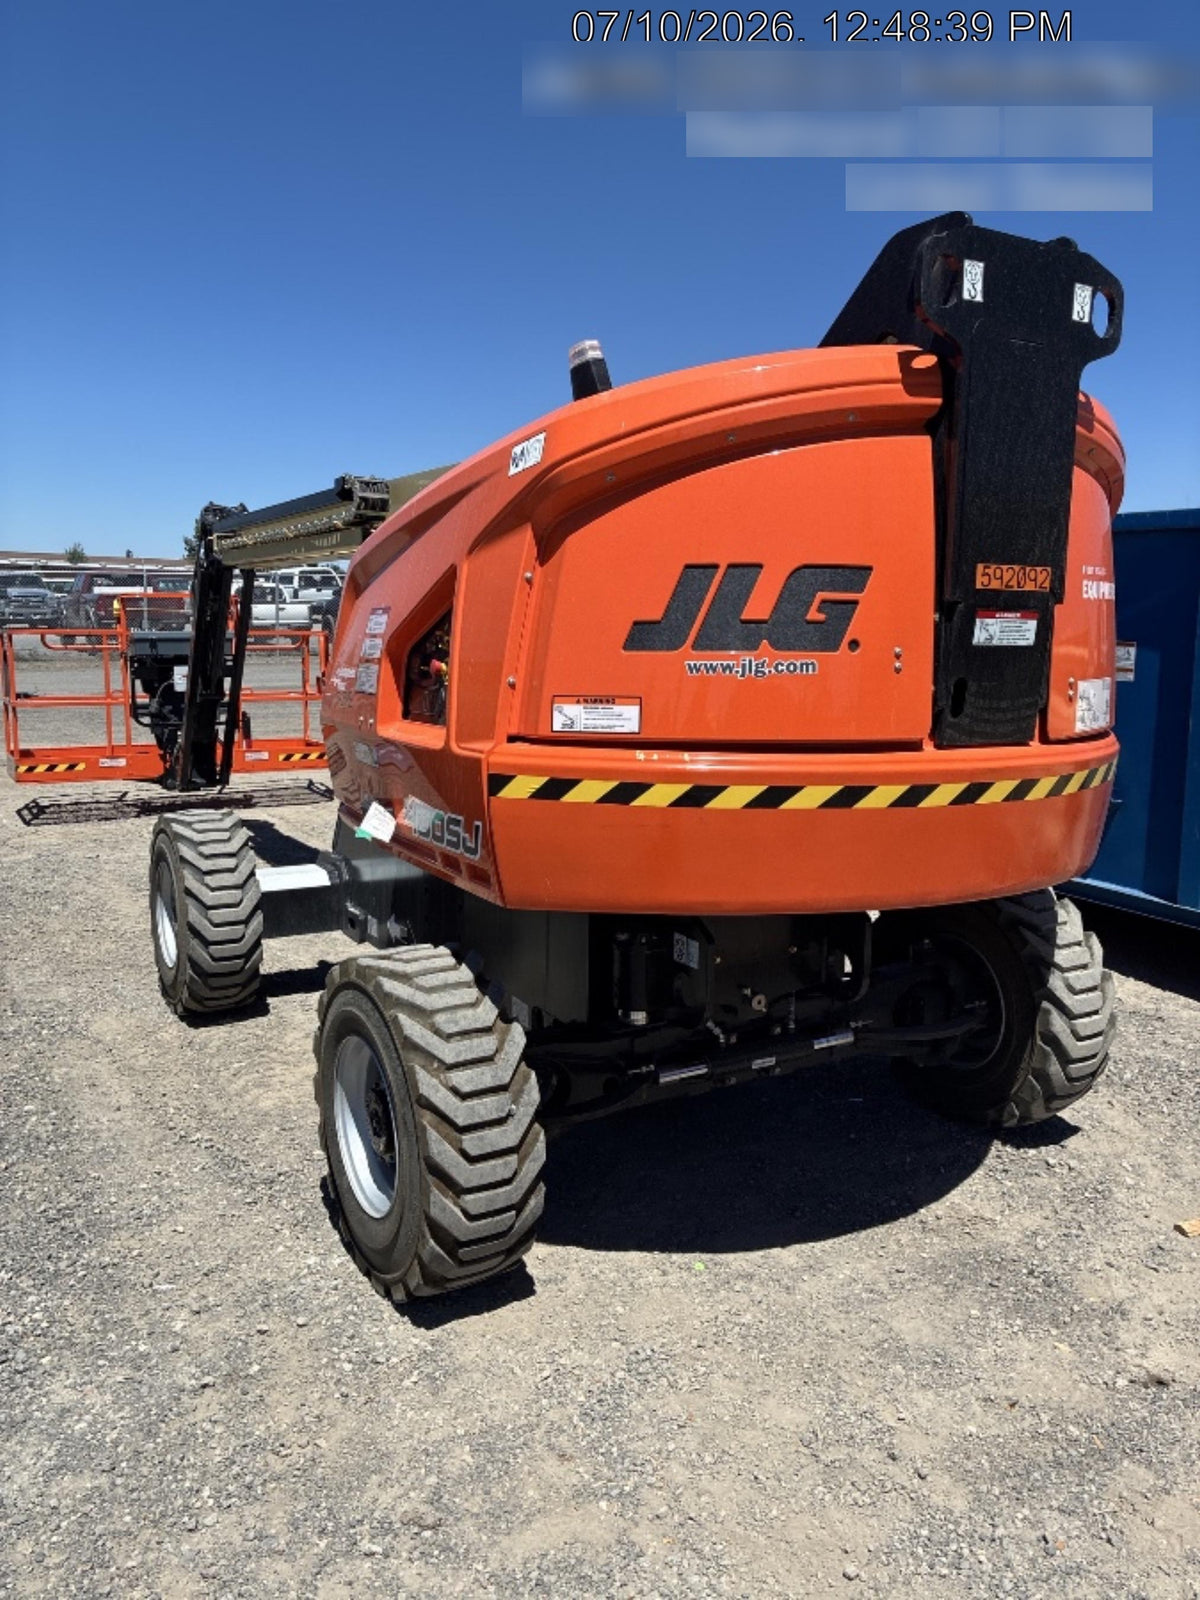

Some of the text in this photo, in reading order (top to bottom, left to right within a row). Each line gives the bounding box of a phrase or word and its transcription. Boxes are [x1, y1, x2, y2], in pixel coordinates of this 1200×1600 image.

[981, 565, 1050, 589] 592092
[622, 562, 873, 652] JLG
[686, 658, 818, 678] www.jlg.com
